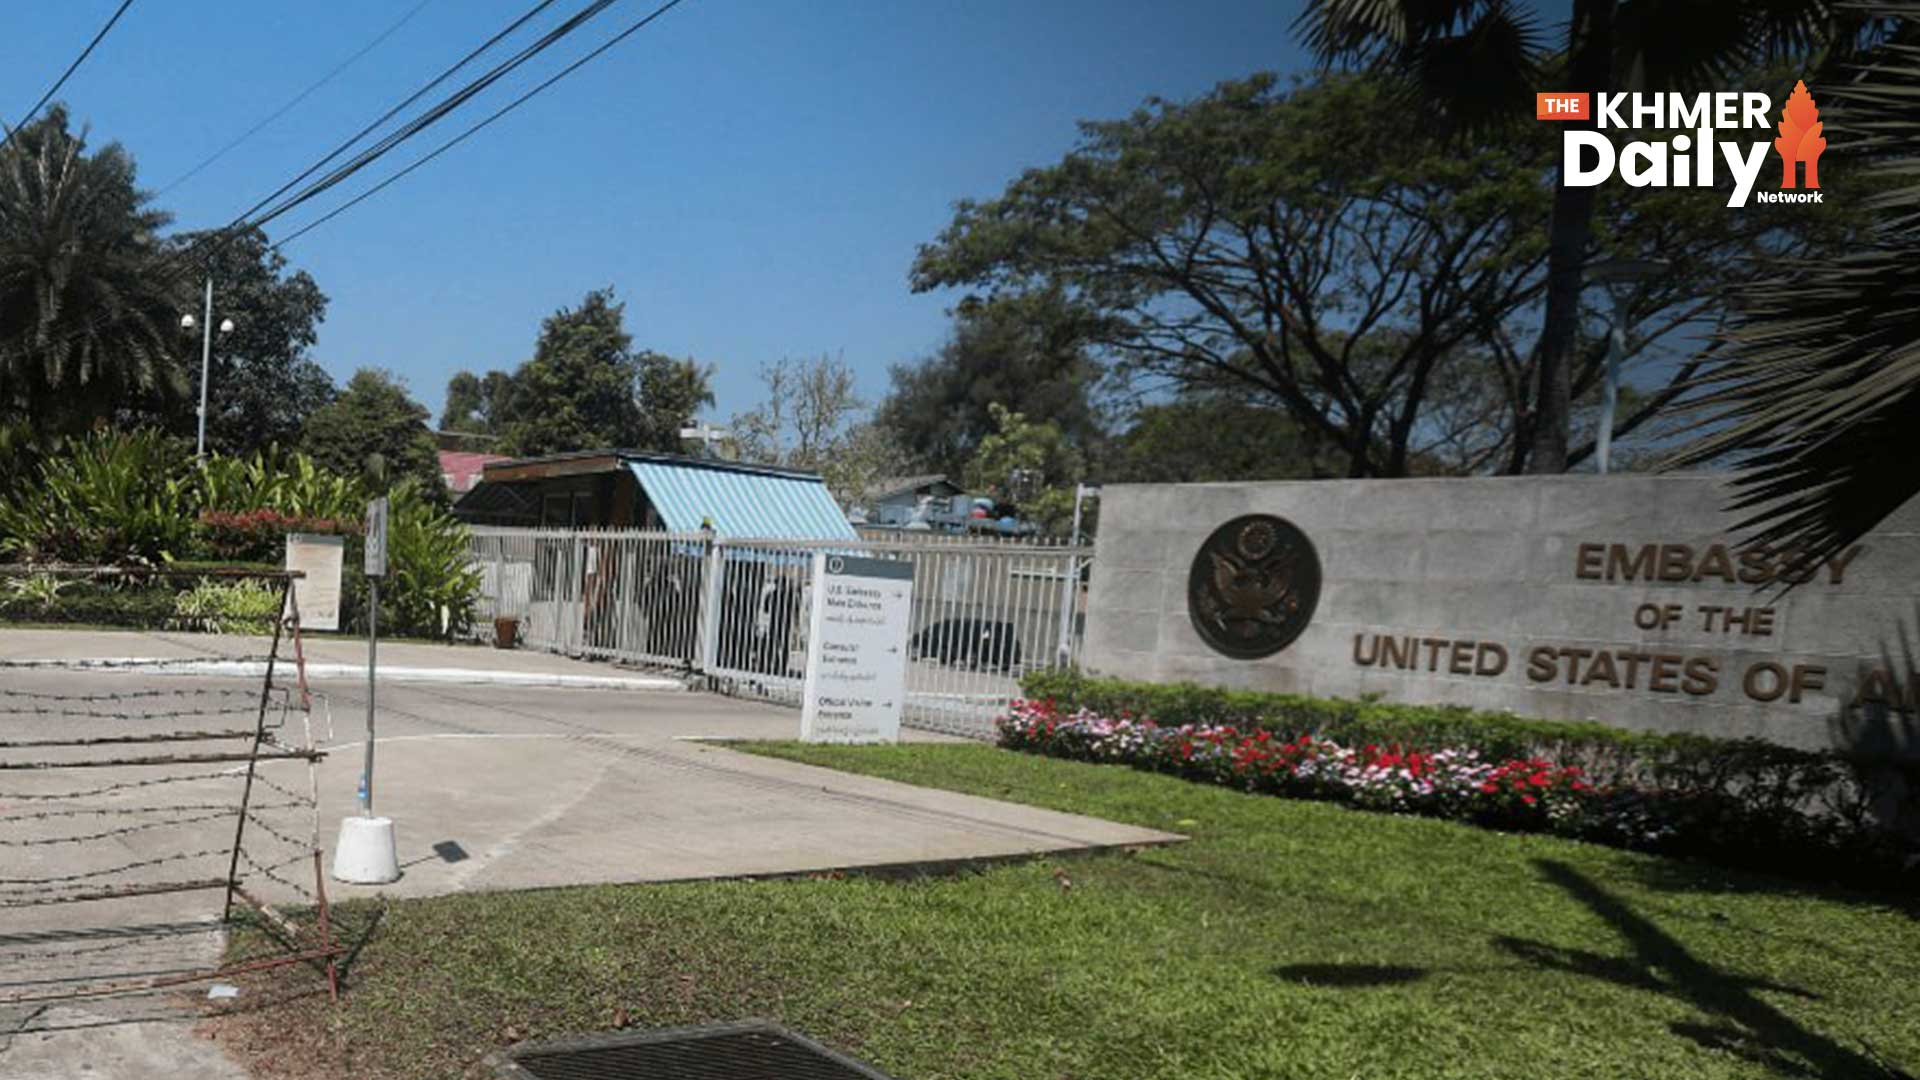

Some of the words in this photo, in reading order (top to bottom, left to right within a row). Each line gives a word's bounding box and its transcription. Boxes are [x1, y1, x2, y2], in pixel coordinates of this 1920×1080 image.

[1634, 603, 1682, 631] OF
[1699, 605, 1776, 636] THE
[1353, 633, 1508, 677] UNITED
[1527, 646, 1720, 696] STATES
[1743, 661, 1827, 703] OF
